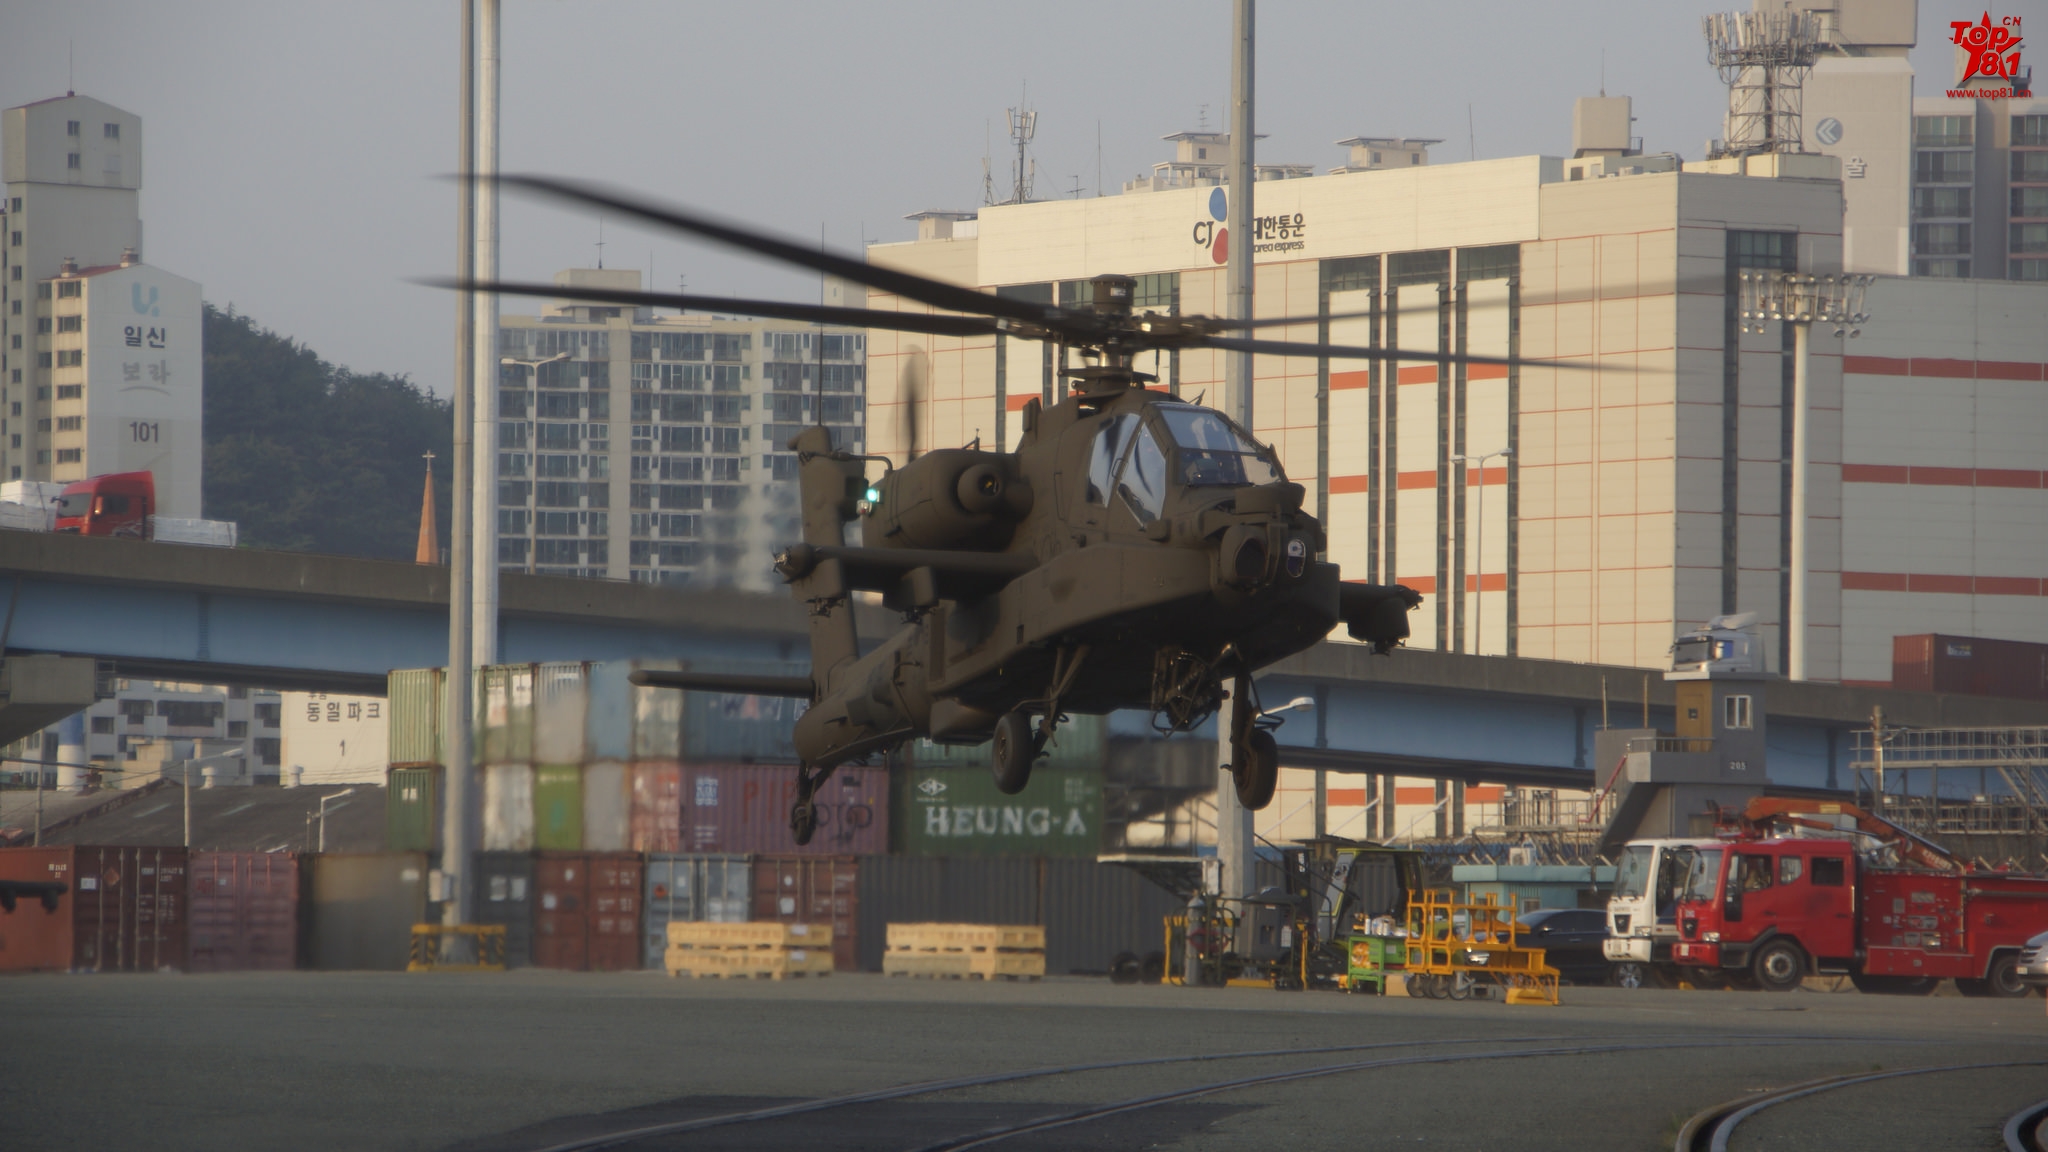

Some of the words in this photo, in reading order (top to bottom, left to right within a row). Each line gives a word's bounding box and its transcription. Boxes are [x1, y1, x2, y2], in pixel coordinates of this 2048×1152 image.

[1193, 220, 1214, 249] CJ
[1253, 243, 1273, 253] orea
[1274, 241, 1304, 253] express
[124, 326, 166, 348] 일신
[122, 359, 171, 385] 보라
[129, 421, 159, 442] 101
[306, 701, 382, 722] 동일파크
[924, 806, 1088, 836] HEUNG-A
